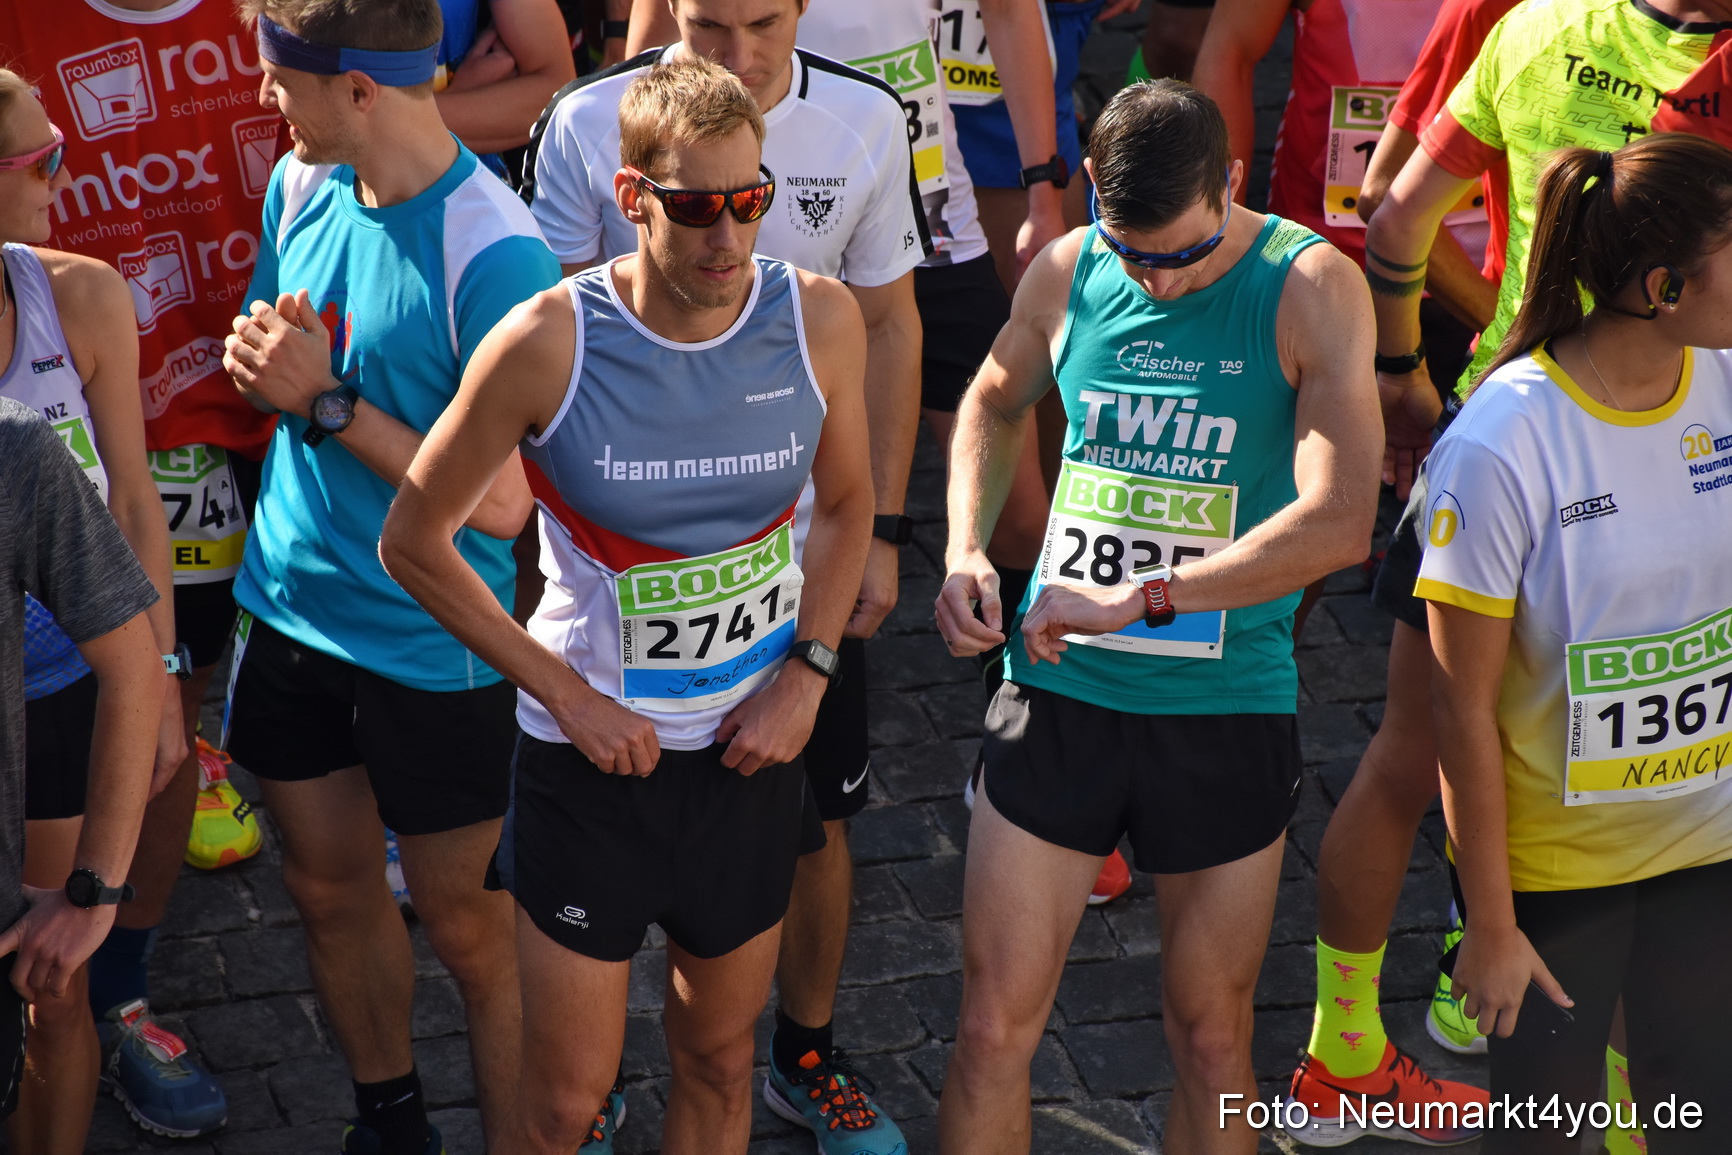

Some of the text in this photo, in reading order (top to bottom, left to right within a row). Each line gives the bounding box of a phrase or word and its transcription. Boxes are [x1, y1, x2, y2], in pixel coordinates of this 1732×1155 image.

[65, 48, 139, 81] raumbox
[1565, 53, 1642, 101] Team
[927, 97, 934, 105] C
[787, 177, 847, 187] NEUMARKT
[67, 194, 223, 246] wohnen outdoor
[806, 201, 828, 218] ASV
[903, 231, 915, 250] JS
[148, 344, 225, 404] raumbo
[1132, 353, 1205, 372] Fischer
[1137, 370, 1198, 381] AUTOMOBILE
[1219, 360, 1243, 369] TAO
[35, 402, 68, 421] NZ
[1079, 389, 1237, 454] TWin
[594, 432, 804, 480] team memmert
[1083, 445, 1228, 479] NEUMARKT
[1683, 432, 1713, 460] 20
[221, 480, 229, 490] A
[1067, 475, 1211, 528] BOCK
[1561, 494, 1616, 522] BOCK
[640, 537, 777, 606] BOCK
[646, 584, 781, 660] 2741
[1586, 620, 1732, 684] BOCK
[1598, 672, 1732, 748] 1367
[1622, 742, 1730, 787] NANCY
[556, 912, 589, 929] Kalenji
